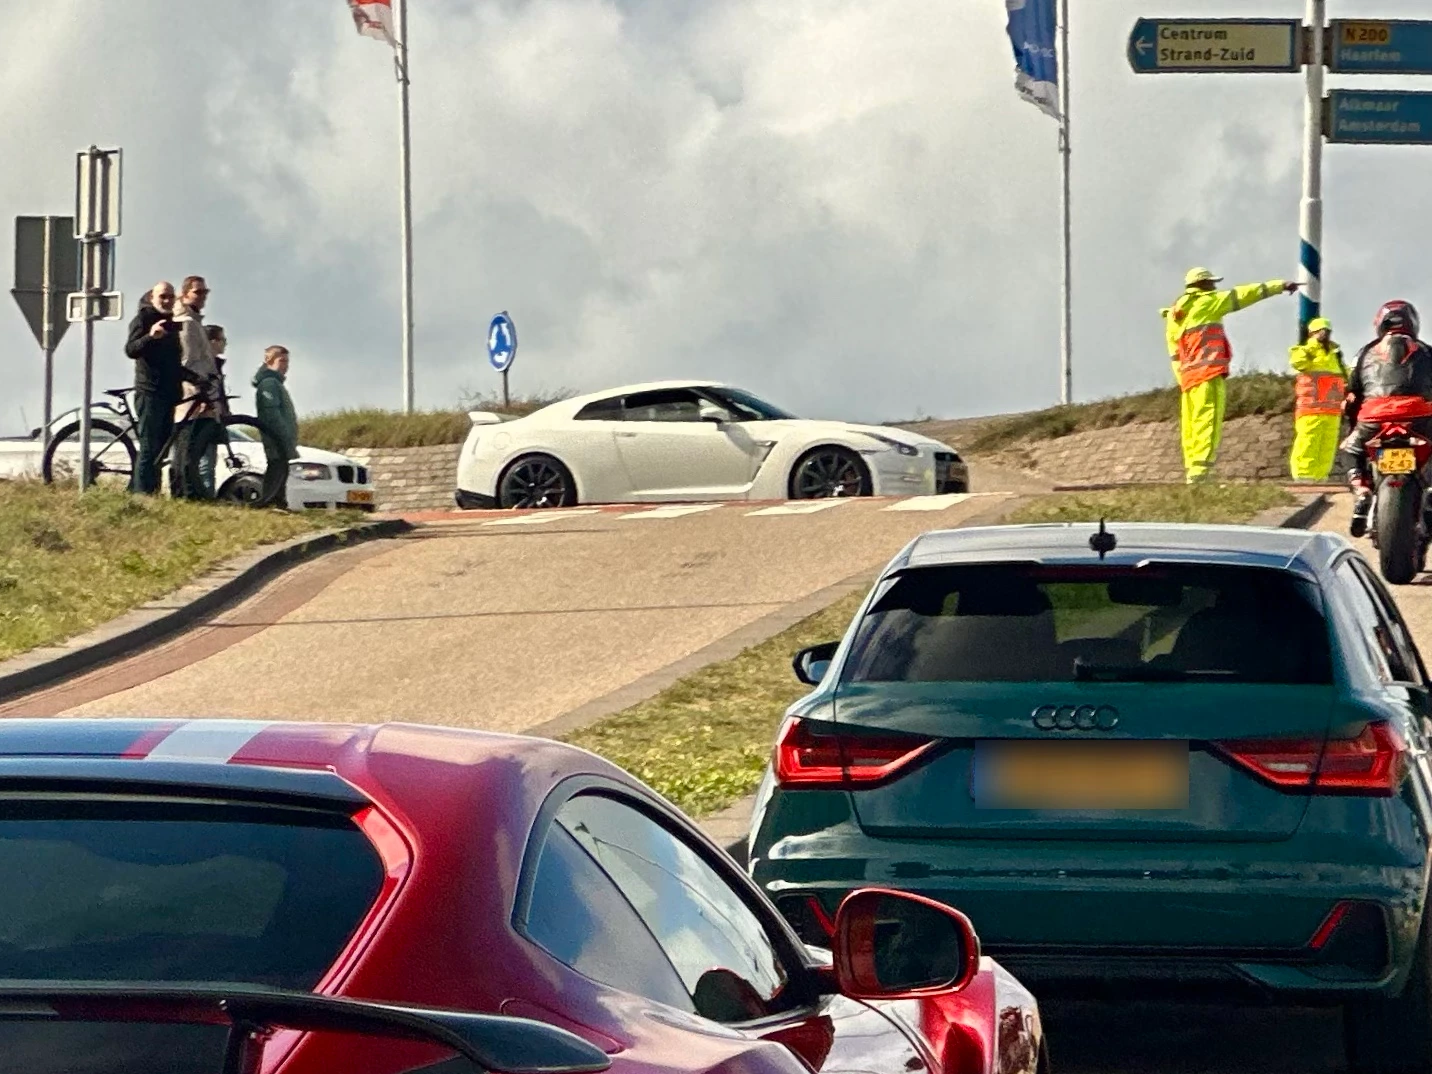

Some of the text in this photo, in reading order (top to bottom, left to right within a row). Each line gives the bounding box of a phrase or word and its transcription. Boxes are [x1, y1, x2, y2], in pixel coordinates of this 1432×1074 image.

[1160, 27, 1228, 40] Centrum
[1345, 28, 1389, 41] N 200
[1159, 47, 1255, 61] Strand-Zuid
